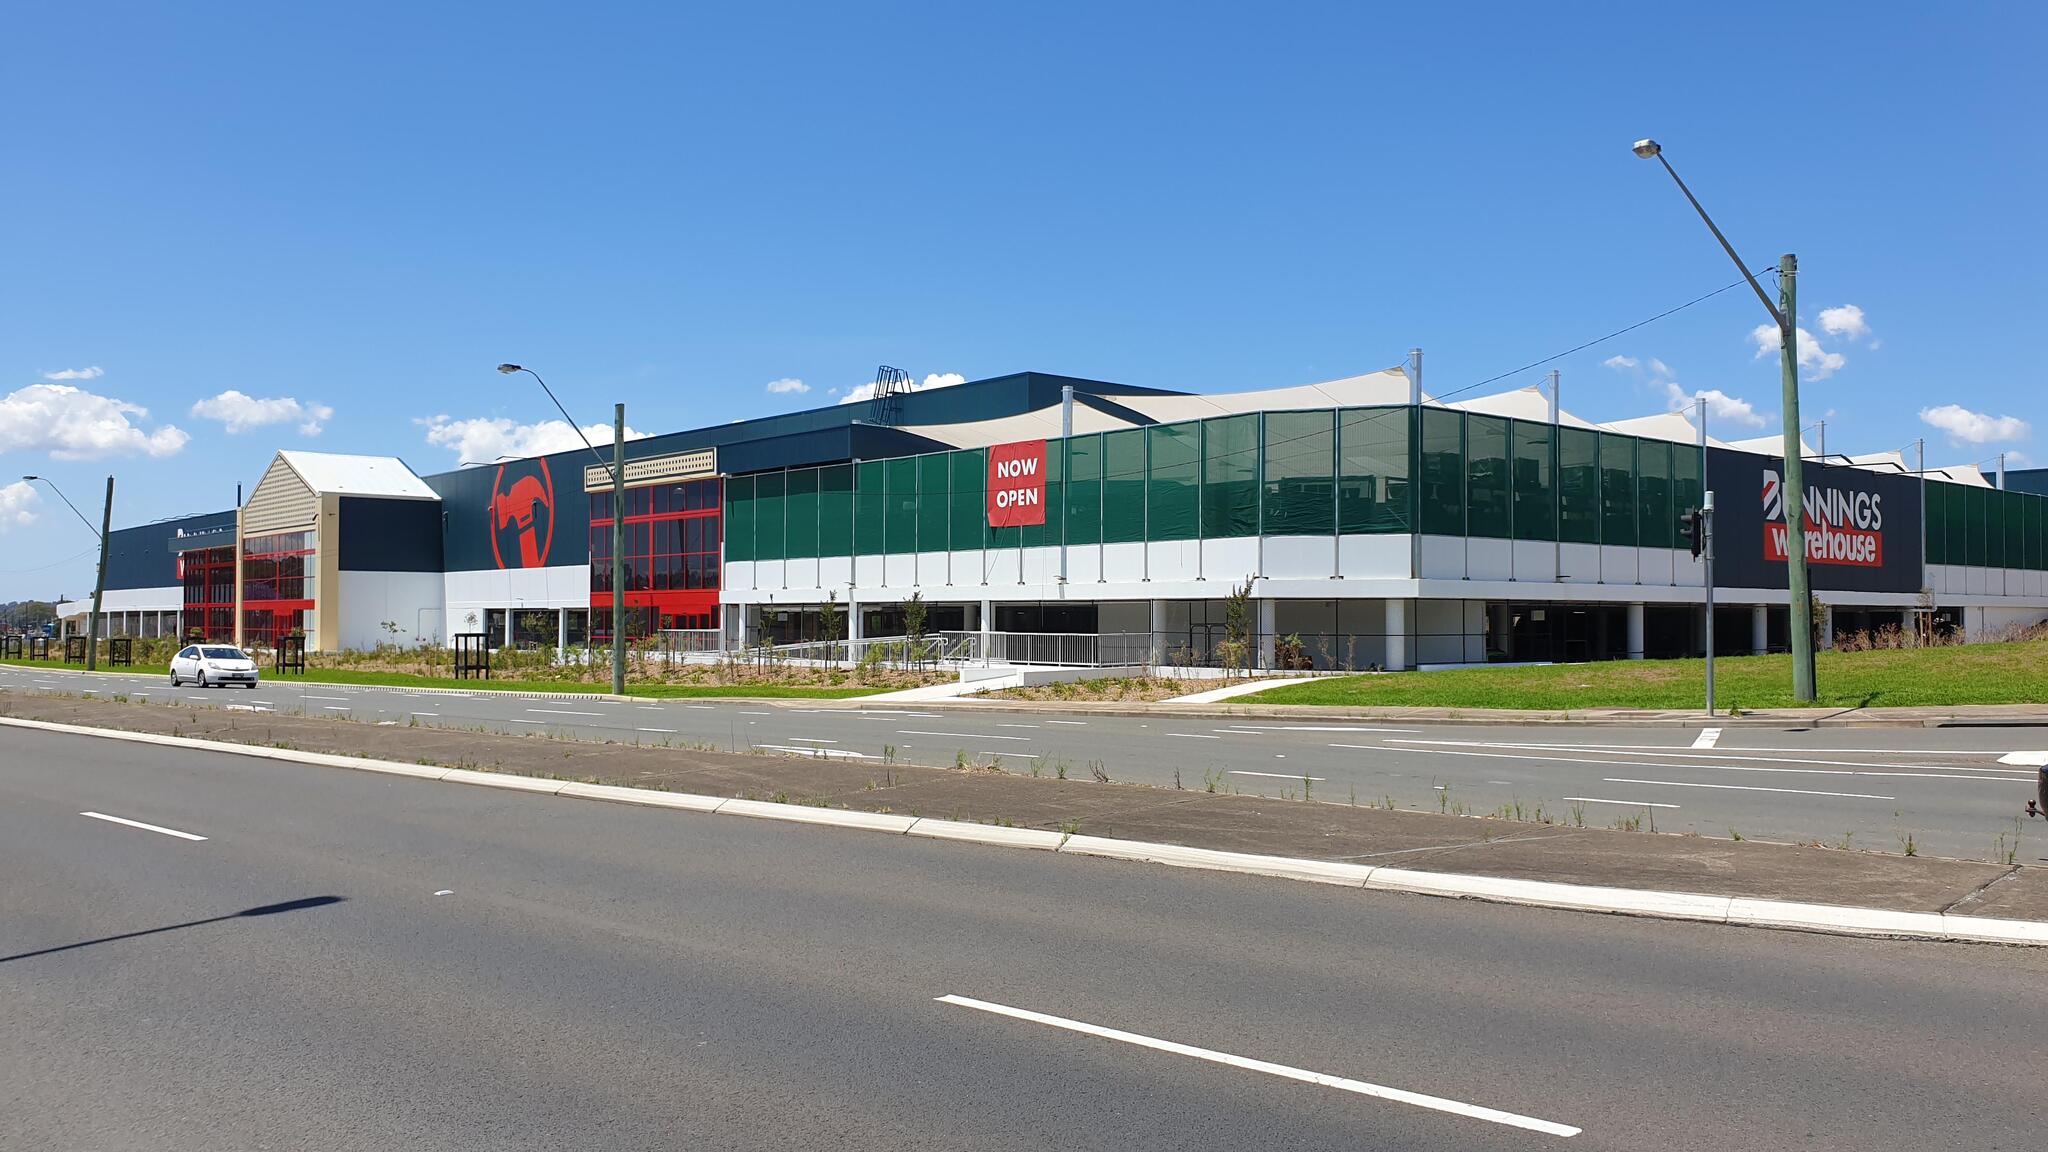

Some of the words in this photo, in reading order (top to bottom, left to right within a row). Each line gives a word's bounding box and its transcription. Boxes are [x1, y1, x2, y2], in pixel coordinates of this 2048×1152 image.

[997, 458, 1038, 478] NOW
[996, 488, 1038, 508] OPEN
[1771, 518, 1876, 563] wrehouse
